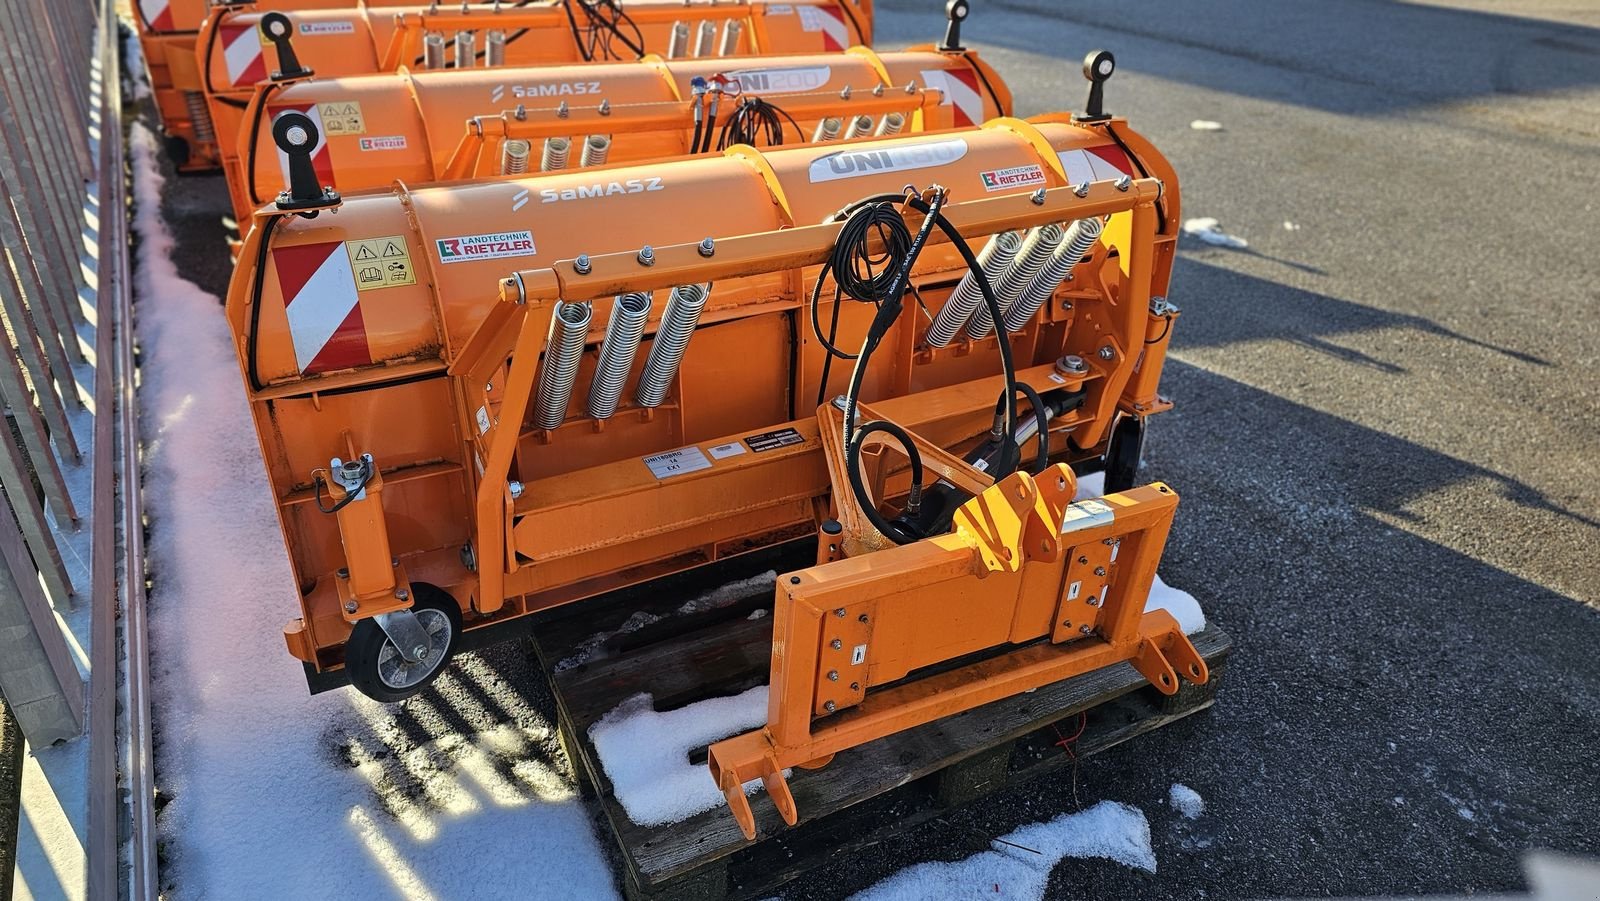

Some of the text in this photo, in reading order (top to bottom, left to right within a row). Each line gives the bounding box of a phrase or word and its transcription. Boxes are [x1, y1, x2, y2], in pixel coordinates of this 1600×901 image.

[996, 165, 1040, 177] LANDTECHNIK
[999, 171, 1044, 185] RIETZLER
[540, 176, 665, 204] SaMASZ
[461, 232, 529, 245] LANDTECHNIK
[463, 240, 533, 255] RIETZLER
